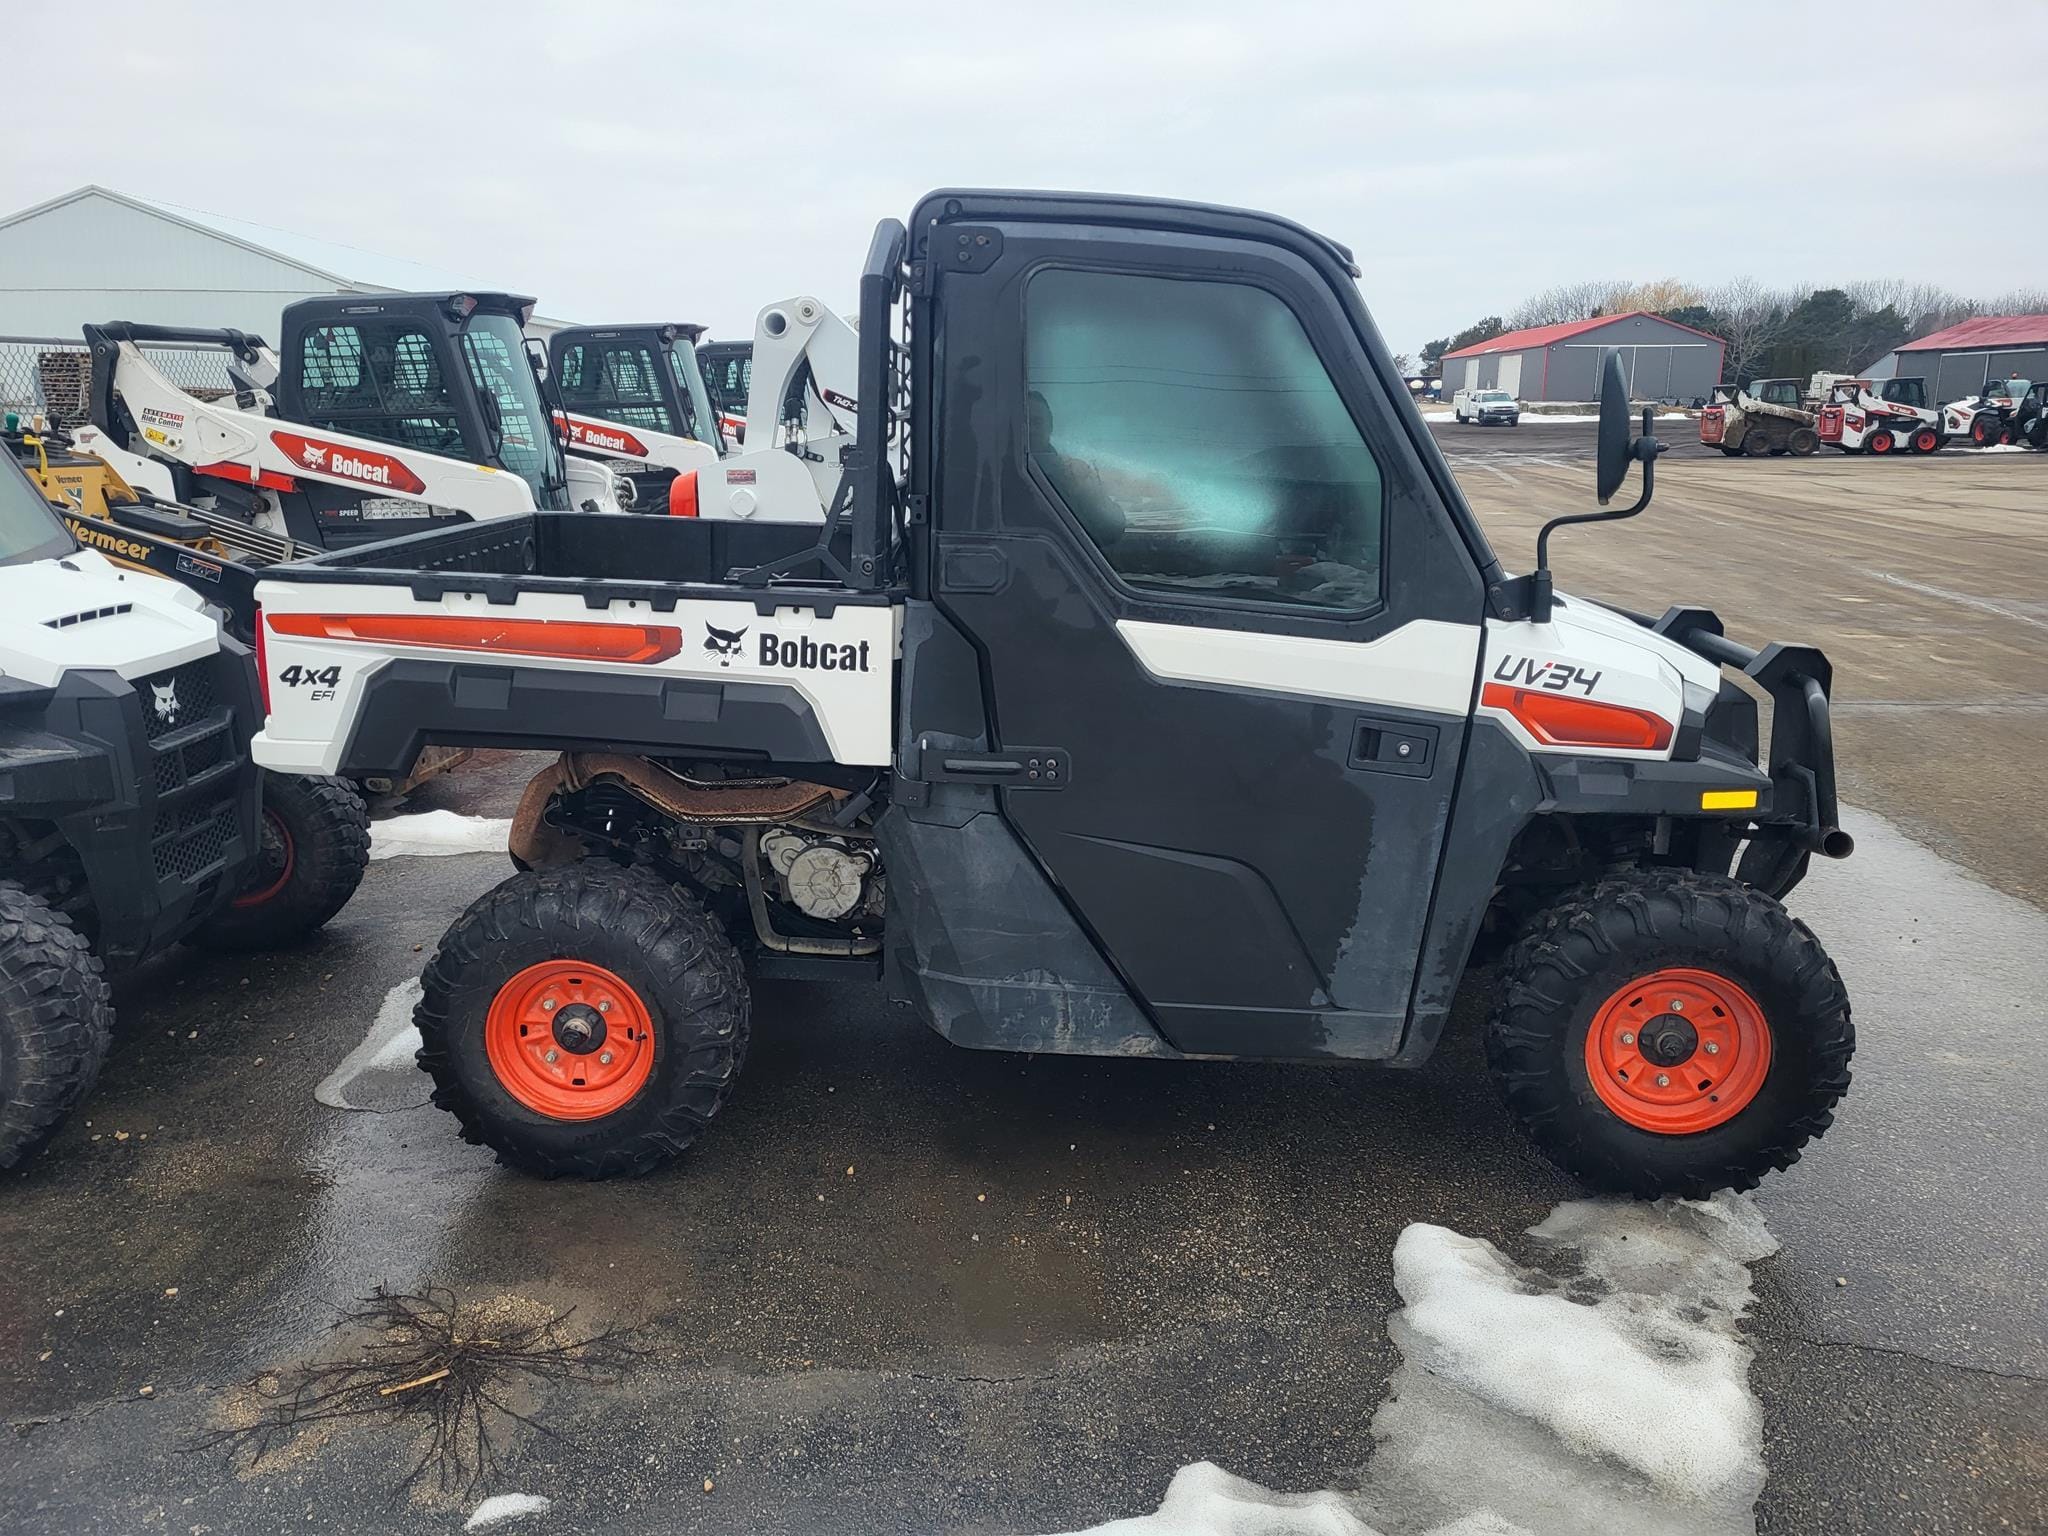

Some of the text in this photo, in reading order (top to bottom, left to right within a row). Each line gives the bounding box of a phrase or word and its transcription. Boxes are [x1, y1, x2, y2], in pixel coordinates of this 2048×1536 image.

[141, 414, 183, 429] Ride Control
[585, 430, 626, 450] Bobcat
[331, 453, 389, 484] Bobcat
[65, 517, 150, 560] Vermeer
[759, 633, 870, 672] Bobcat
[279, 665, 342, 688] 4x4
[1494, 654, 1602, 696] UV34
[310, 690, 336, 701] EFI
